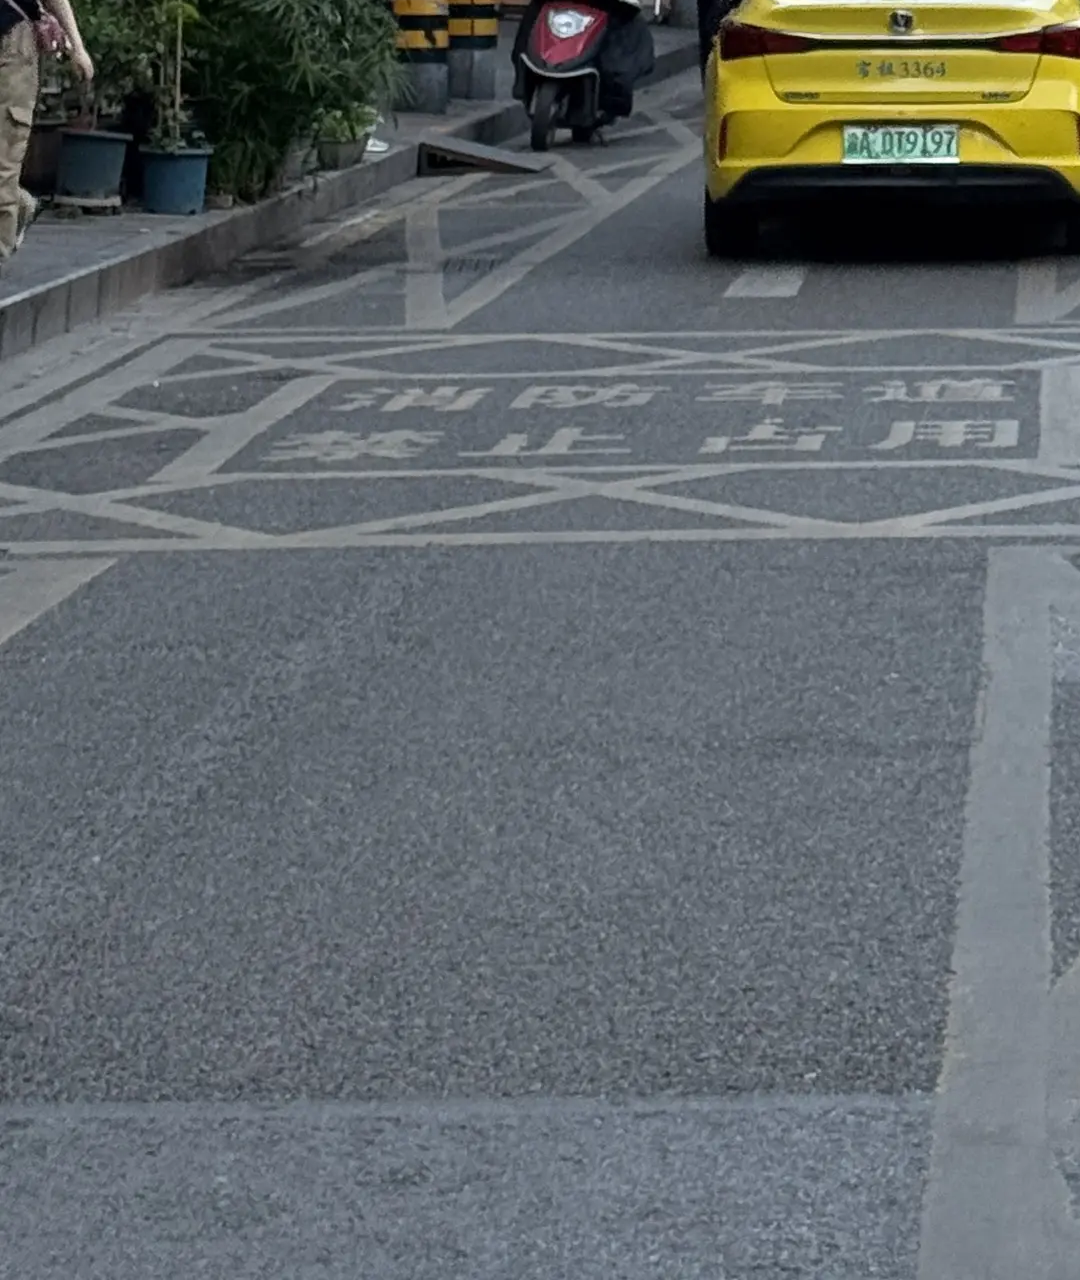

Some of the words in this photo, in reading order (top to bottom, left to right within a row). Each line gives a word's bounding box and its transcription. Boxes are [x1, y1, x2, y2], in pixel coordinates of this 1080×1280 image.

[329, 377, 1016, 413] 消防车道
[260, 417, 1021, 463] 禁止占用
